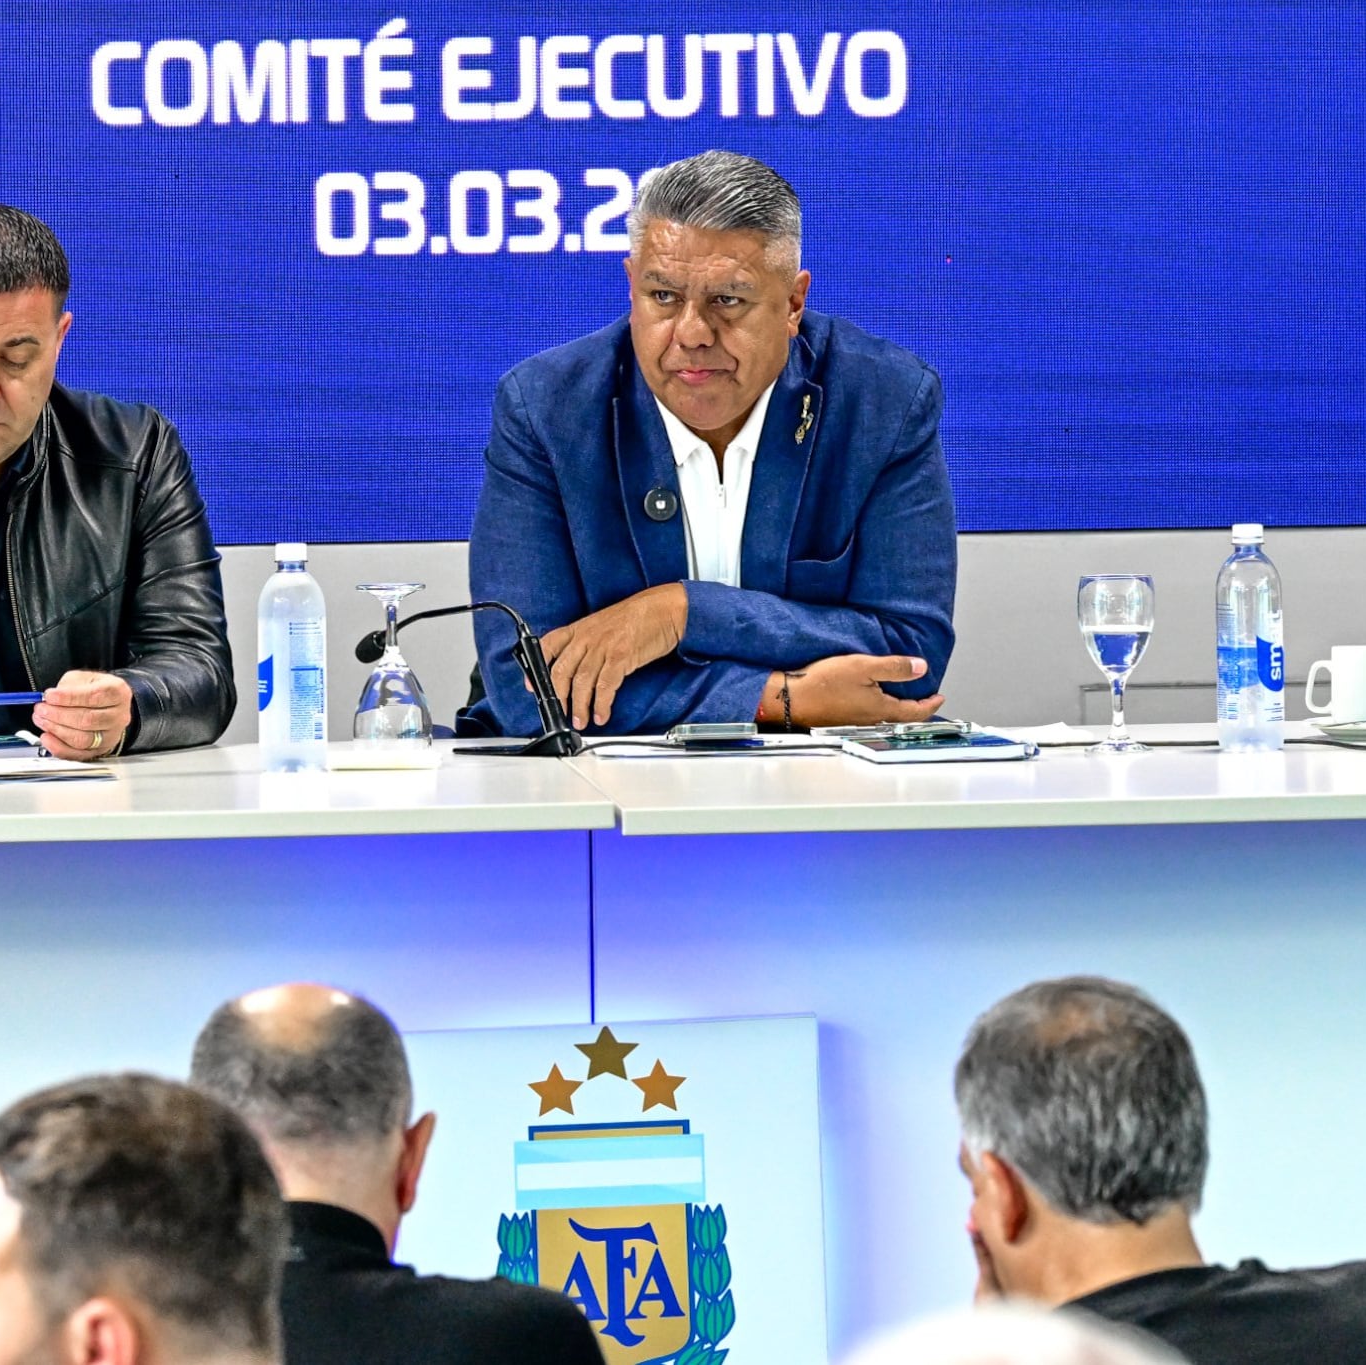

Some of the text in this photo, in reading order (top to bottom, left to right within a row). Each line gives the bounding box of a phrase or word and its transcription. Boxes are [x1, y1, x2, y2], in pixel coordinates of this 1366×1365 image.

[91, 18, 908, 127] COMITÉ EJECUTIVO
[314, 167, 665, 256] 03.03.2
[561, 1217, 686, 1348] AFA
